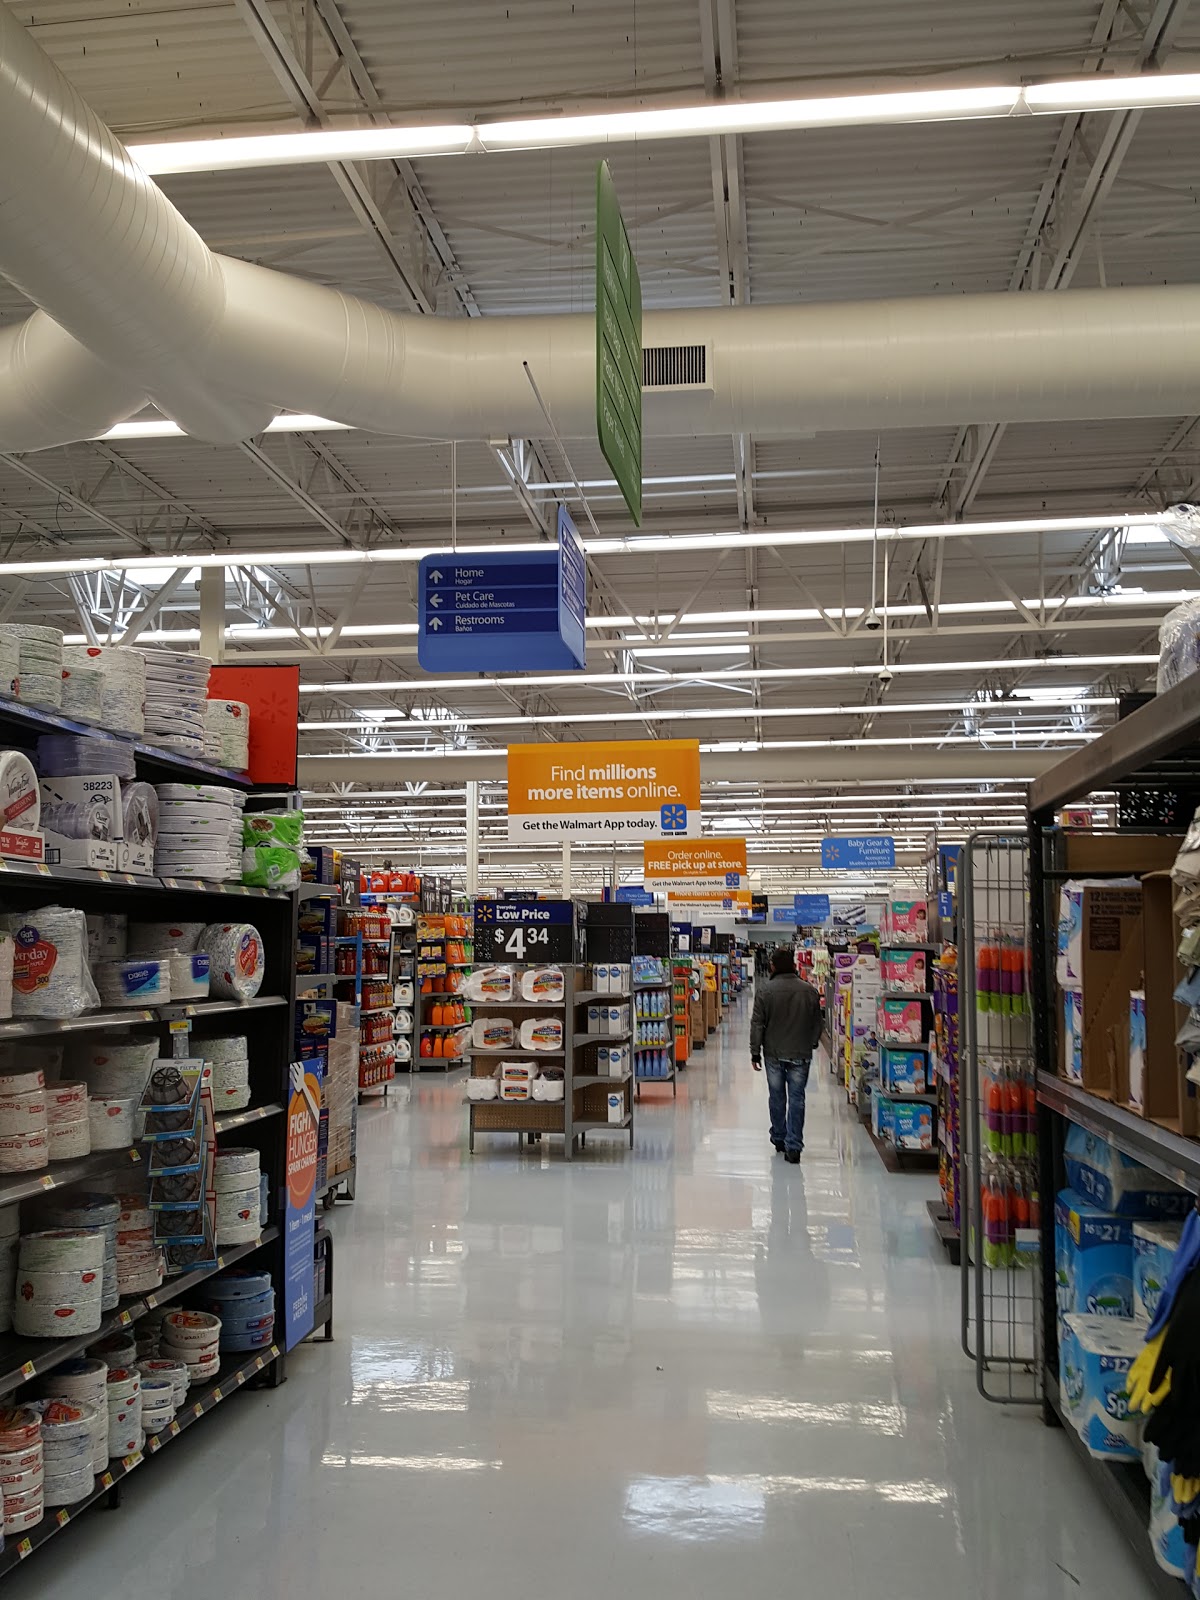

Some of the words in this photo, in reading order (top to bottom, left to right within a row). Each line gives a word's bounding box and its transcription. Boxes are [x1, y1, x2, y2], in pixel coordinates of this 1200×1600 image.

[455, 568, 484, 578] Home
[455, 578, 473, 586] Hogar
[455, 592, 471, 601] Pet
[473, 591, 494, 601] Care
[455, 615, 505, 625] Restrooms
[551, 765, 585, 782] Find
[589, 763, 657, 781] millions
[83, 781, 113, 791] 38223
[528, 787, 573, 800] more
[577, 784, 624, 799] items
[627, 782, 681, 798] online.
[522, 821, 540, 830] Get
[541, 820, 558, 829] the
[559, 818, 602, 829] Walmart
[604, 819, 625, 831] App
[626, 818, 658, 831] today.
[848, 840, 865, 848] Baby
[667, 850, 693, 860] Order
[694, 850, 723, 859] online.
[648, 861, 671, 871] FREE
[672, 860, 691, 871] pick
[693, 862, 706, 871] up
[707, 860, 717, 869] at
[717, 860, 743, 868] store.
[941, 893, 948, 903] E
[496, 909, 520, 920] Low
[521, 909, 550, 920] Price
[942, 906, 947, 915] 1
[37, 975, 49, 985] 300
[289, 1110, 311, 1137] FIGHT
[289, 1130, 317, 1161] HUNGER
[300, 1153, 317, 1170] CHANGE
[1101, 1226, 1121, 1241] 21
[1113, 1358, 1130, 1373] 12
